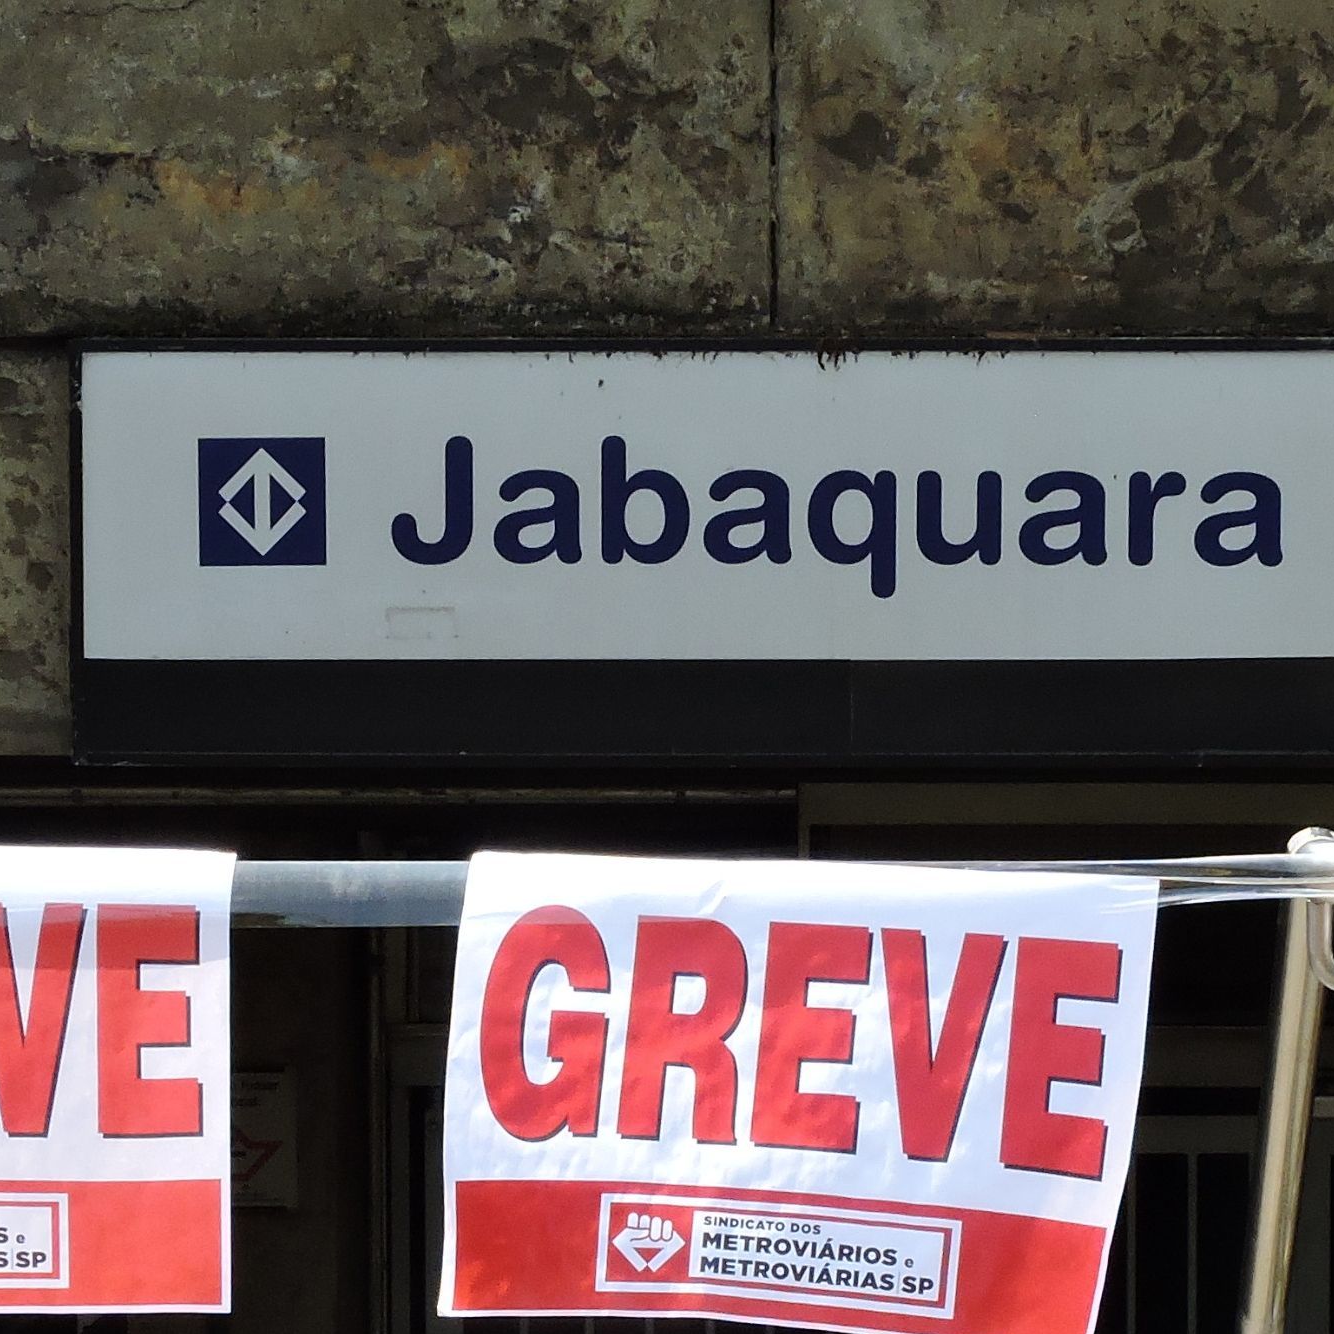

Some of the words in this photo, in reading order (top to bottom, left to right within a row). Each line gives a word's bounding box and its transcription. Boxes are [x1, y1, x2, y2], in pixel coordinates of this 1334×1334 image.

[390, 435, 1283, 599] Jabaquara
[480, 904, 1123, 1181] GREVE
[704, 1216, 785, 1232] SINDICATO
[790, 1224, 821, 1235] DOS
[16, 1252, 46, 1268] SP
[702, 1232, 897, 1266] METROVIÁRIOS
[700, 1256, 894, 1290] METROVIÁRIAS
[902, 1276, 933, 1294] SP
